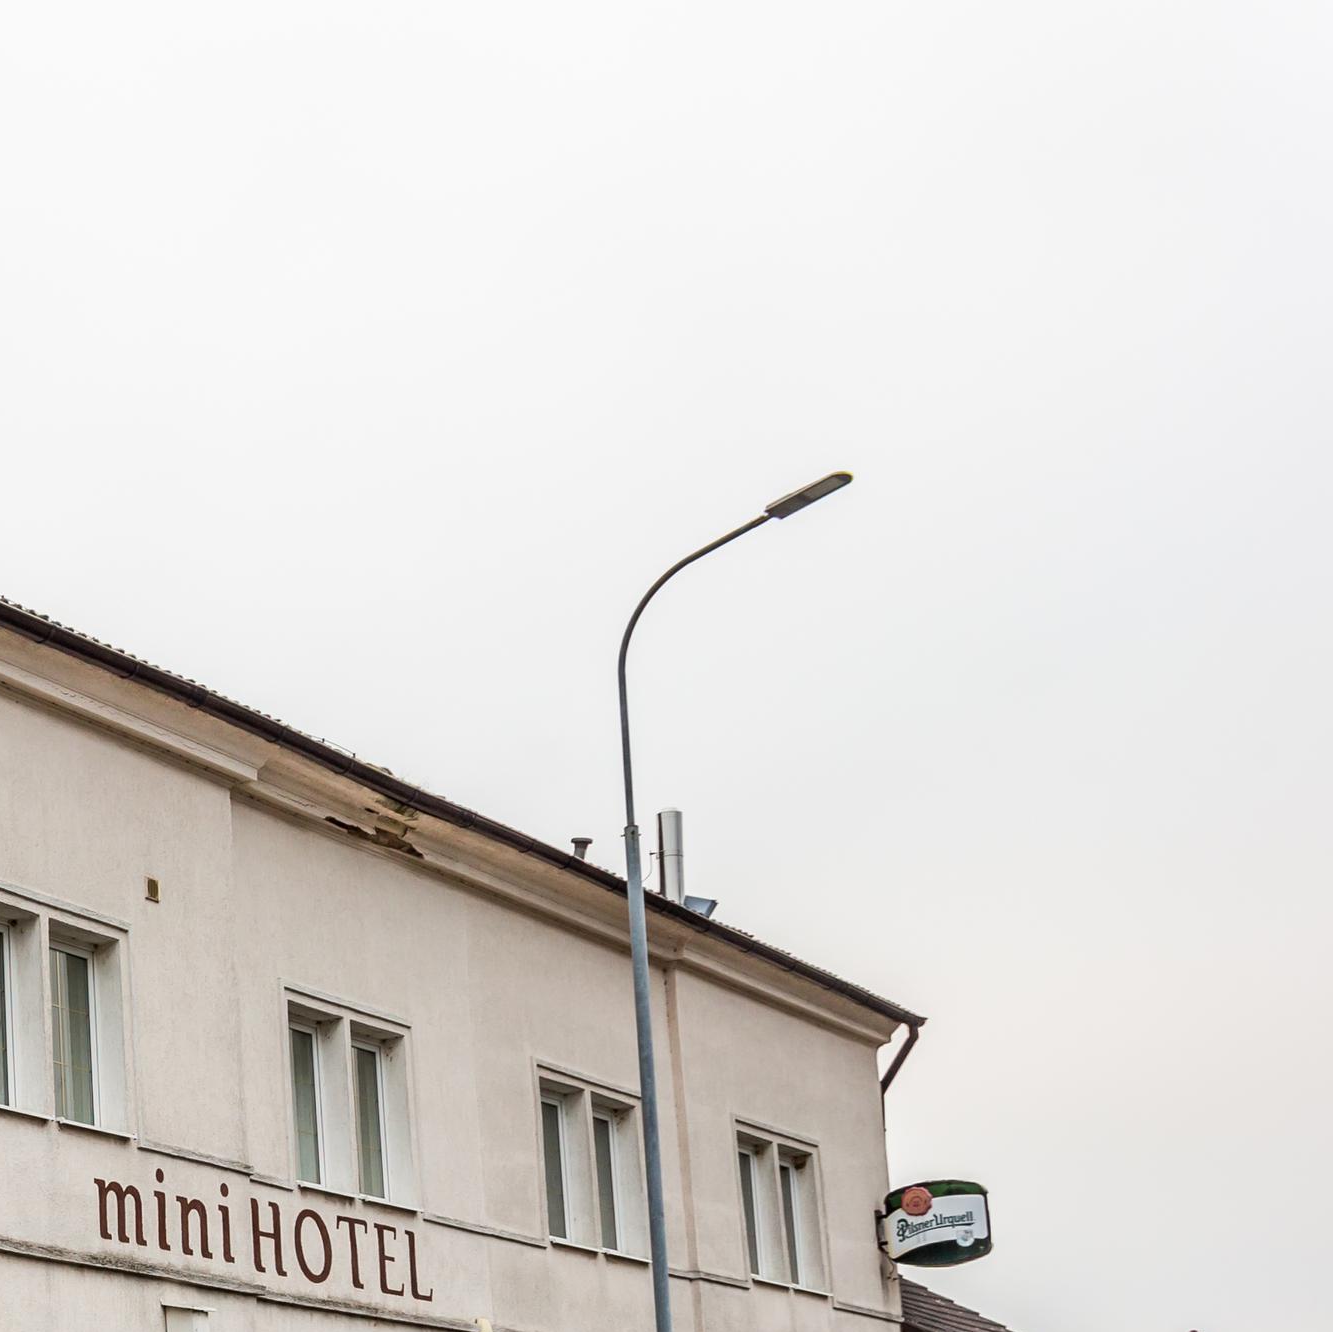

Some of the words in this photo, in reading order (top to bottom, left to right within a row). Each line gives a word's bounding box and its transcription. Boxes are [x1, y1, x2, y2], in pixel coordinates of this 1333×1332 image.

[94, 1168, 235, 1263] mini
[250, 1198, 433, 1302] HOTEL
[896, 1218, 935, 1242] Pilsner
[933, 1211, 973, 1228] Urquell
